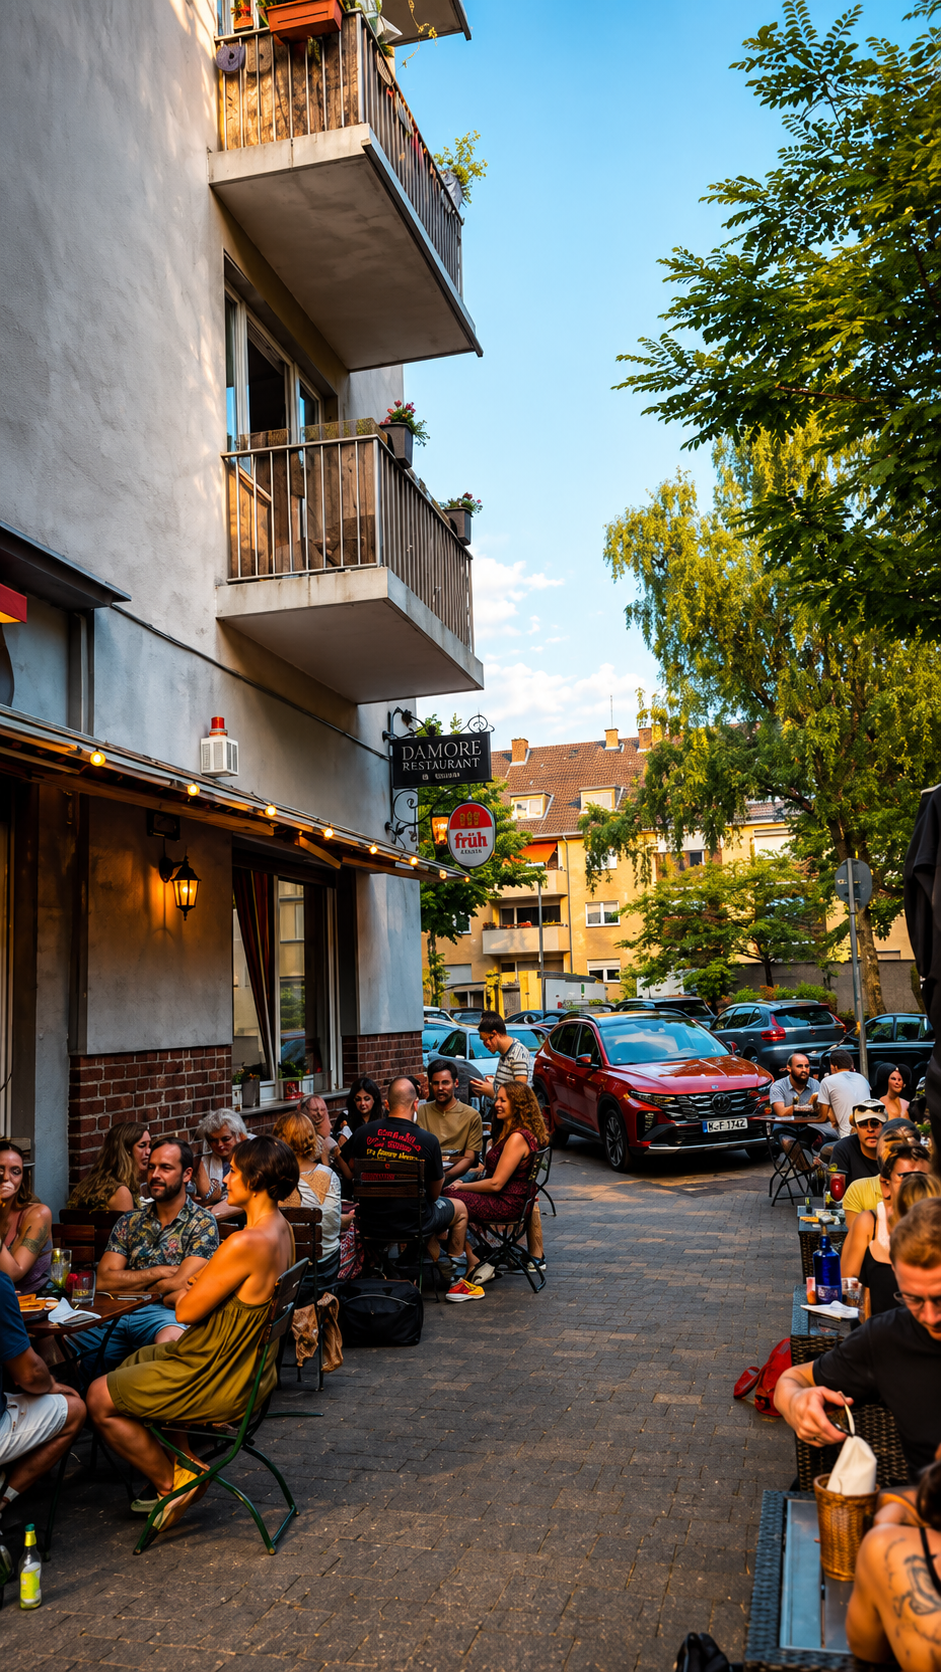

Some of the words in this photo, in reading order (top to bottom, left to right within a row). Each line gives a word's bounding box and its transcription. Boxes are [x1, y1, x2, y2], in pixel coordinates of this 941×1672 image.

[401, 740, 482, 761] DAMORE
[402, 757, 480, 772] RESTAURANT
[454, 831, 488, 849] früh
